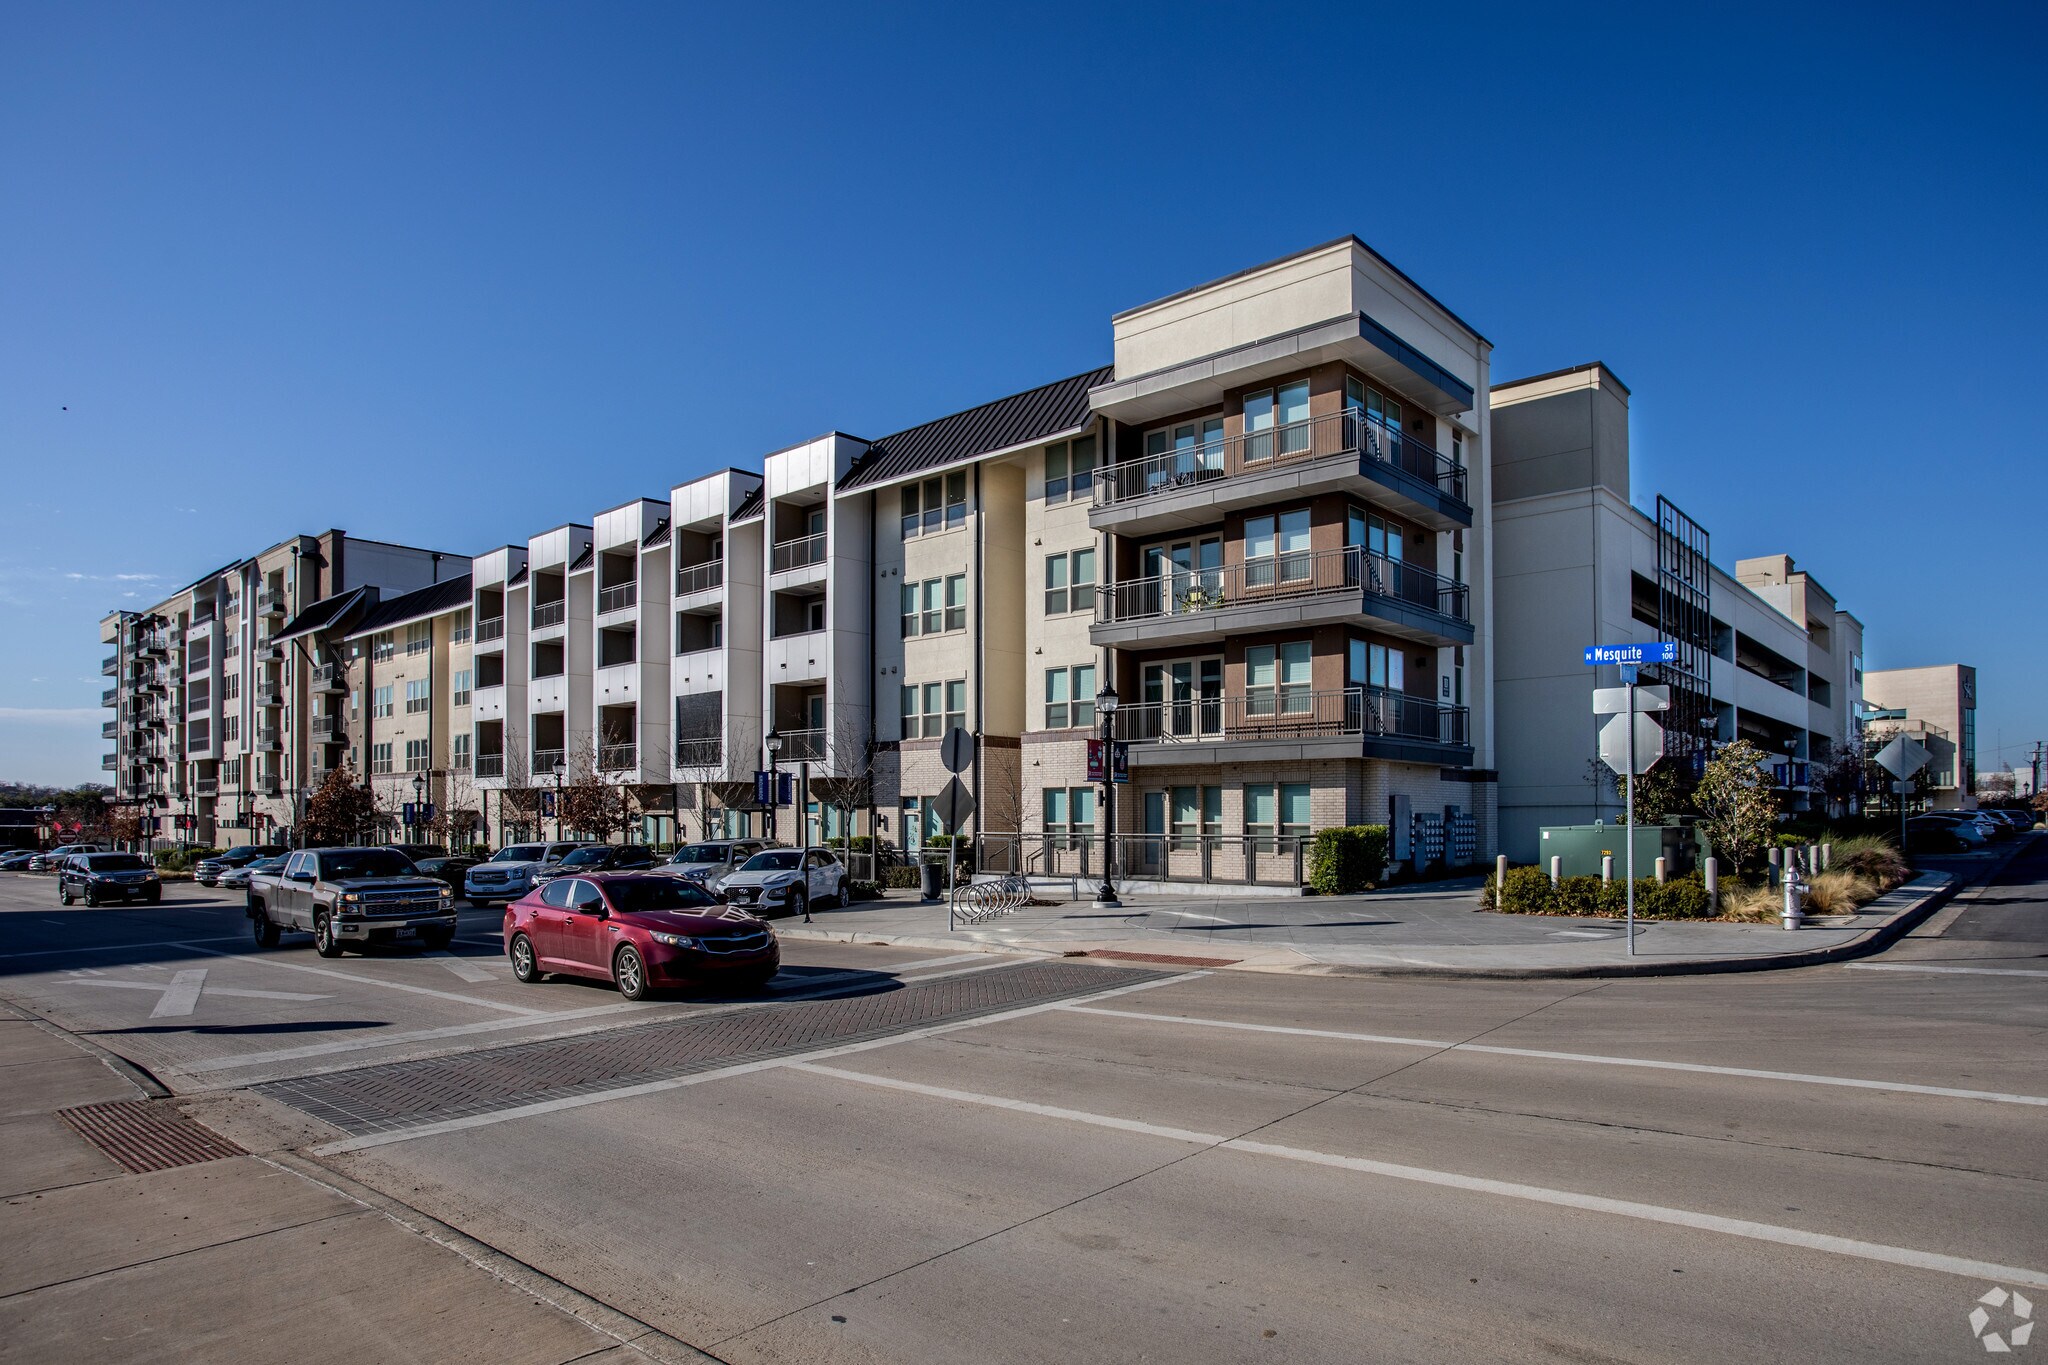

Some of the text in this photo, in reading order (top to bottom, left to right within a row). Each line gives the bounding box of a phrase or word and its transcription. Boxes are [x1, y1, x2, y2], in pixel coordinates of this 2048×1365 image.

[1664, 644, 1673, 652] ST
[1595, 646, 1642, 663] Mesquite
[1661, 652, 1673, 660] 100
